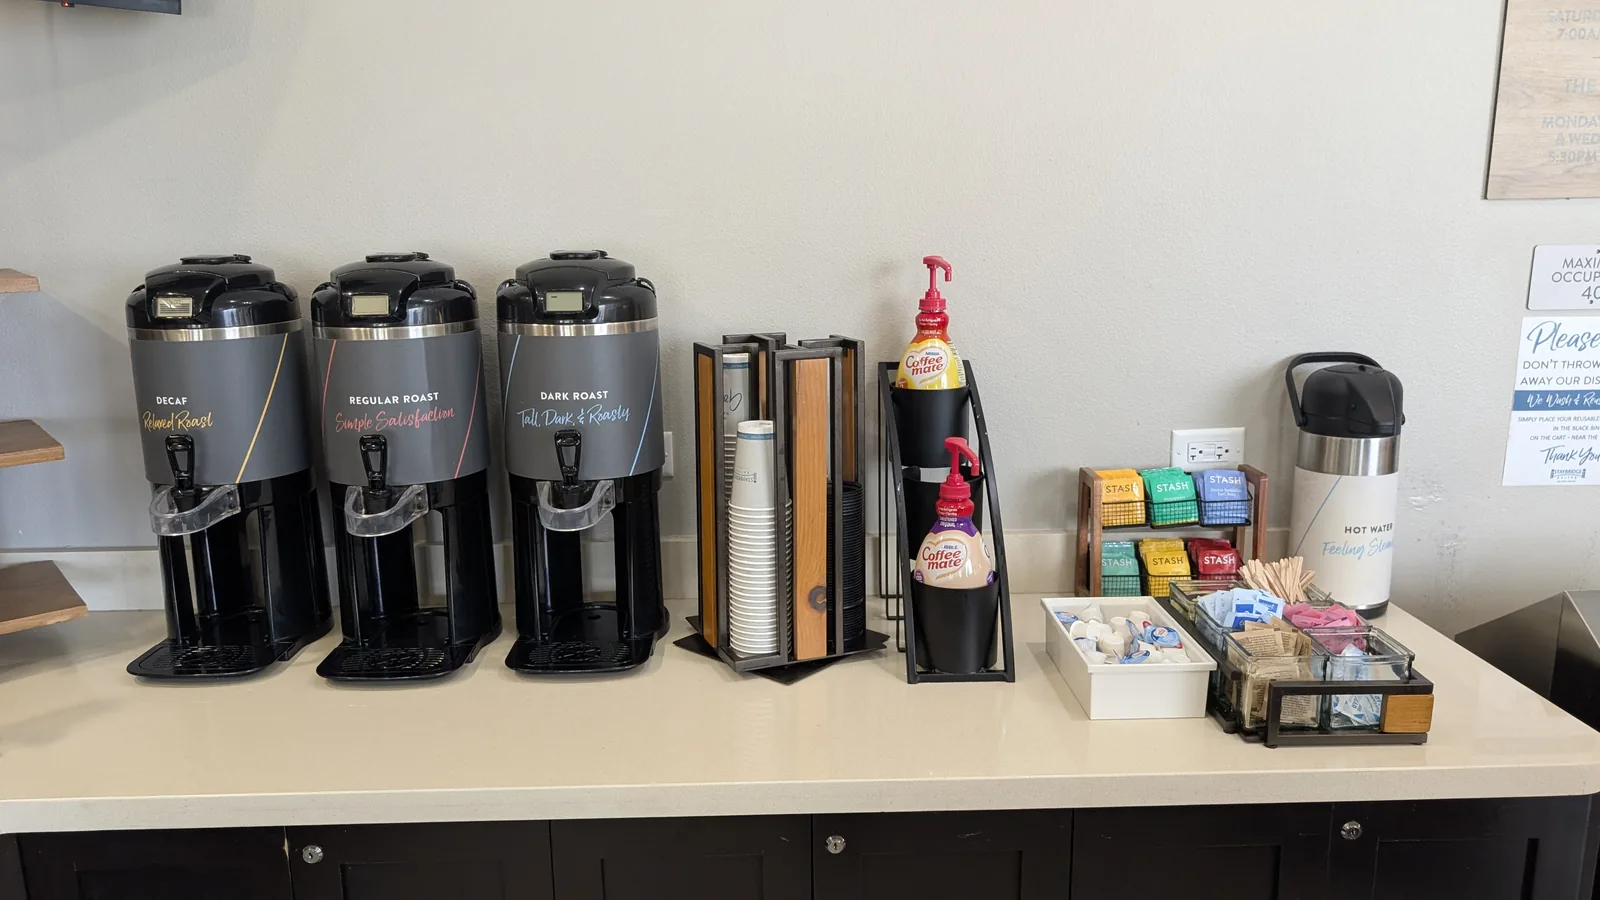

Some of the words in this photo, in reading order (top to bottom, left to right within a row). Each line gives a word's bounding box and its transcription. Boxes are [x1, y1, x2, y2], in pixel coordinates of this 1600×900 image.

[1556, 28, 1600, 40] 7:00A
[1564, 79, 1597, 93] THE
[1549, 150, 1597, 163] 5:30PM
[1527, 320, 1600, 354] Please
[905, 355, 943, 369] Coffee
[1522, 359, 1558, 370] DON'T
[911, 363, 944, 376] mate
[1520, 377, 1553, 386] AWAY
[1556, 376, 1581, 385] OUR
[156, 396, 188, 406] DECAF
[349, 396, 399, 405] REGULAR
[403, 392, 439, 404] ROAST
[540, 391, 569, 401] DARK
[573, 390, 608, 401] ROAST
[1526, 393, 1543, 408] We
[1545, 393, 1572, 408] Wash
[143, 411, 174, 432] Relaxed
[175, 410, 213, 431] Roast
[335, 412, 373, 432] Simple
[375, 406, 456, 432] Satisfaction
[576, 408, 584, 425] &
[1540, 445, 1577, 464] Thank
[1209, 475, 1241, 485] STASH
[1156, 481, 1189, 493] STASH
[1344, 526, 1367, 534] HOT
[1370, 522, 1393, 534] WATER
[922, 546, 961, 561] Coffee
[1322, 541, 1365, 560] Feeling
[927, 558, 962, 570] mate
[1102, 558, 1132, 567] STASH
[1152, 556, 1184, 566] STASH
[1204, 555, 1236, 565] STASH
